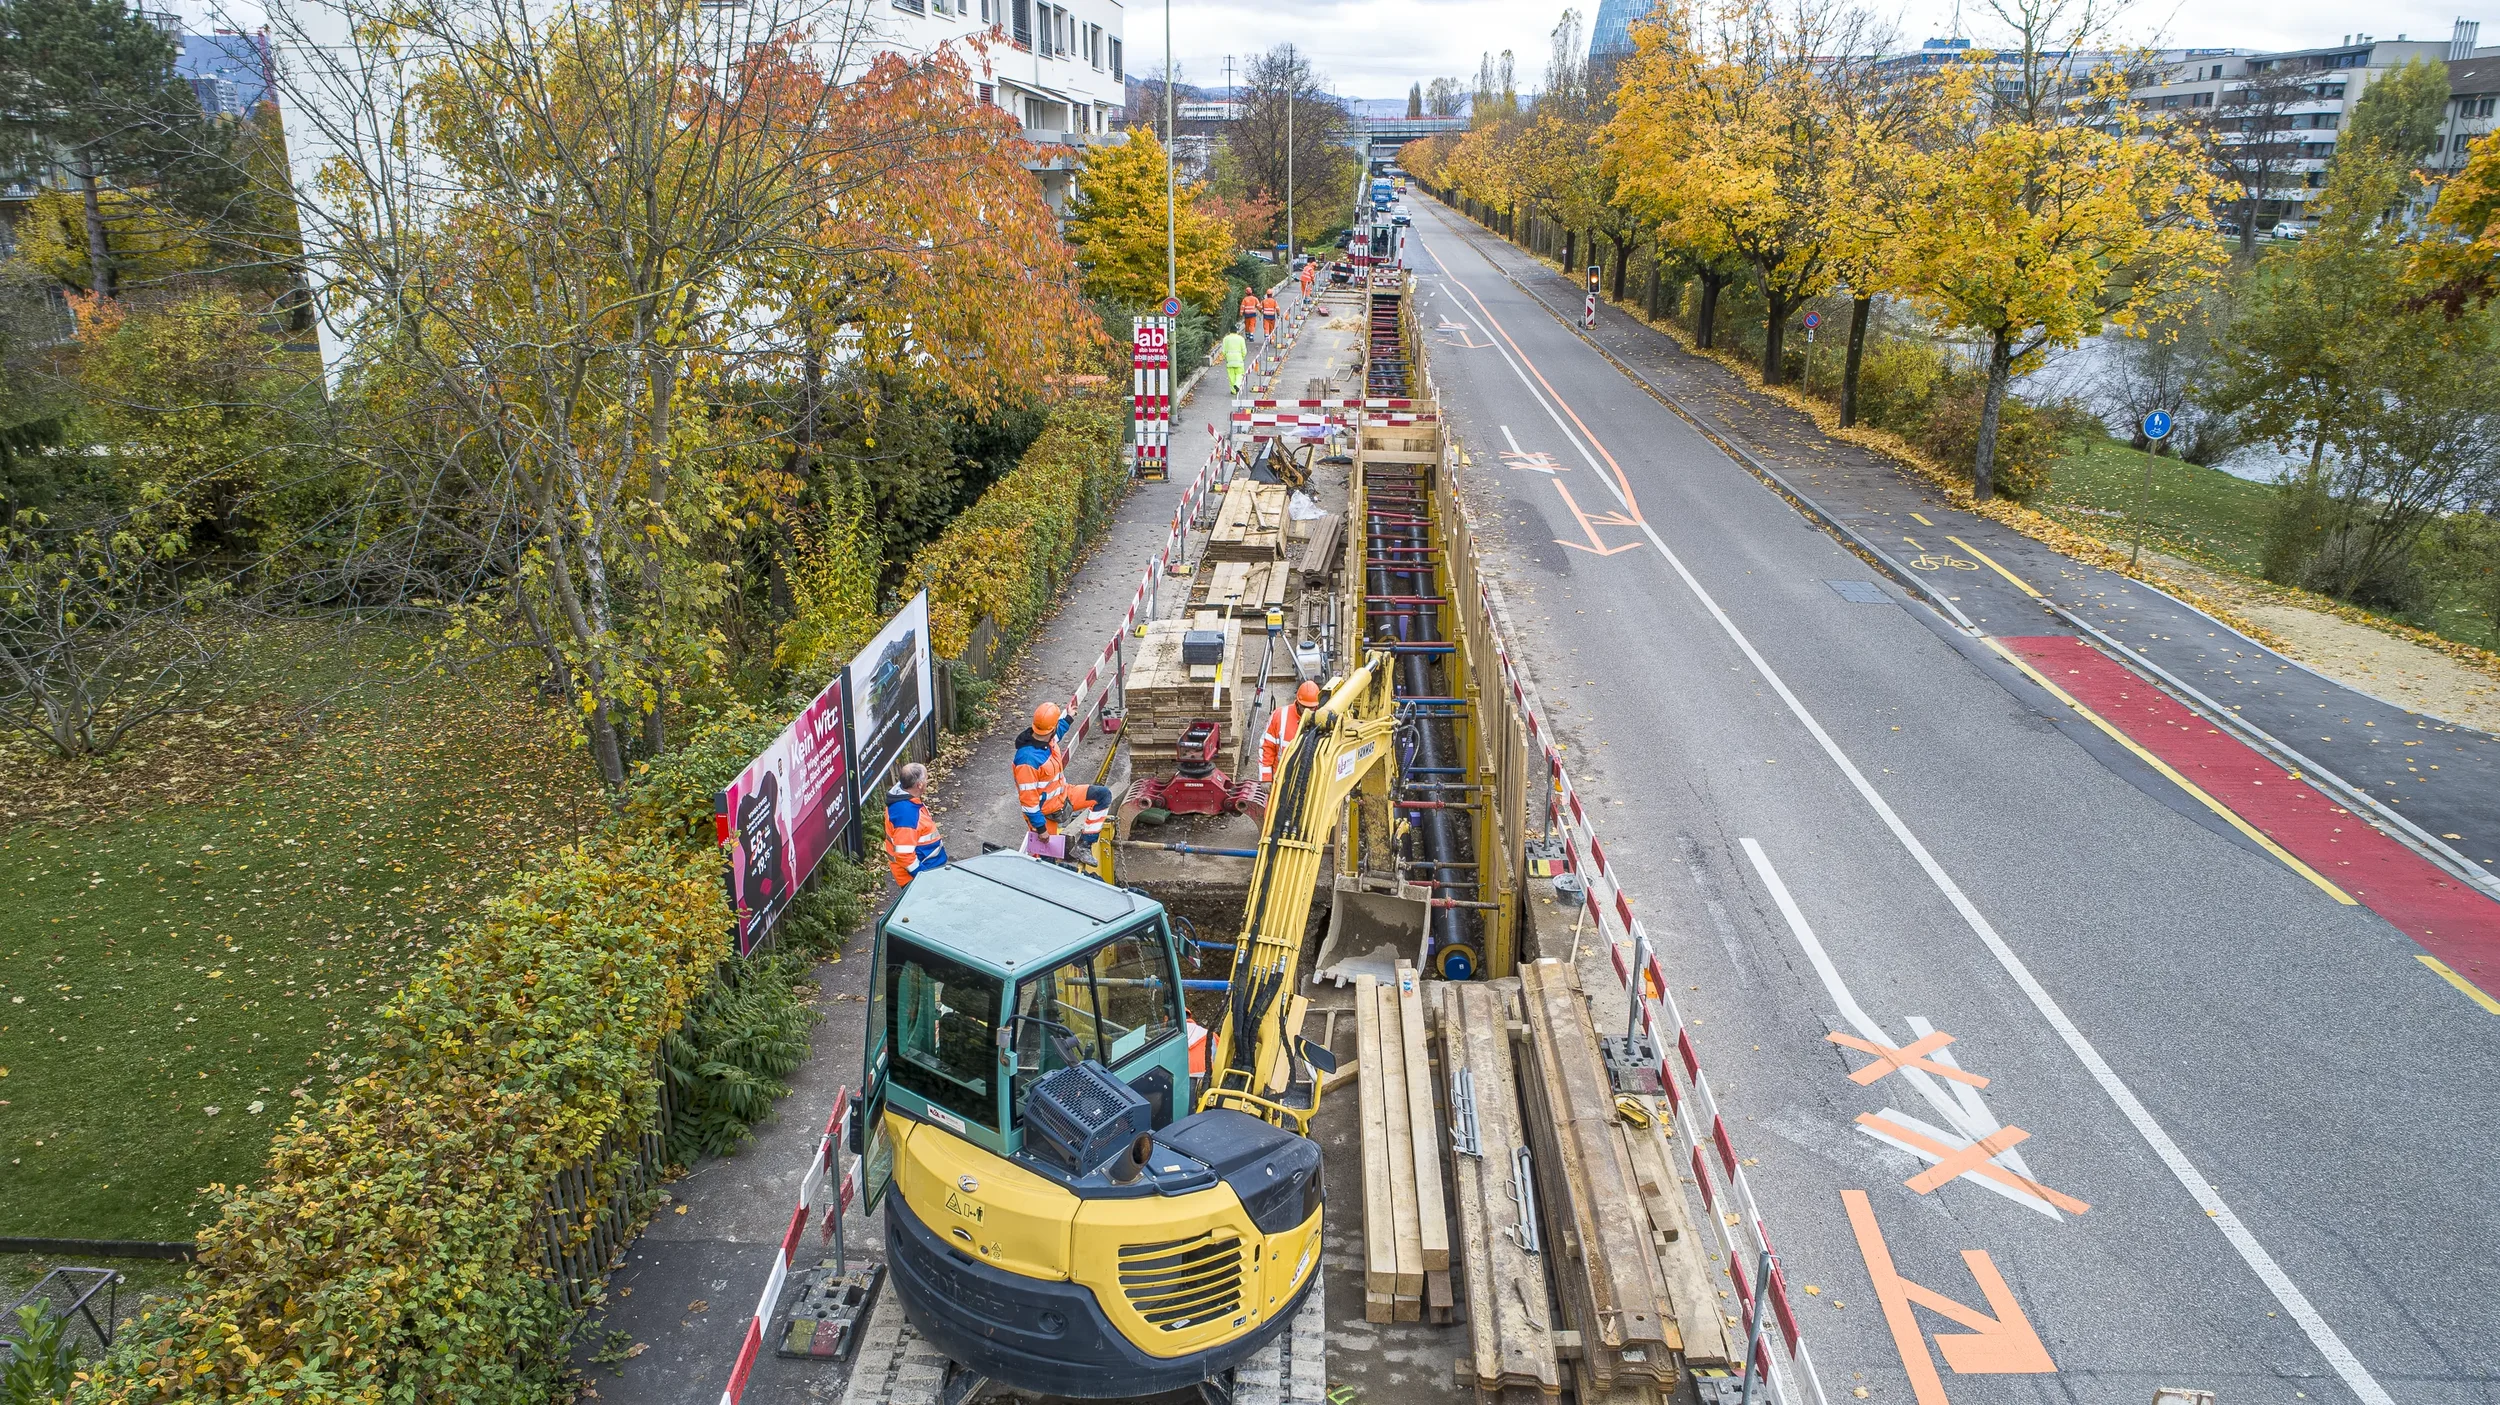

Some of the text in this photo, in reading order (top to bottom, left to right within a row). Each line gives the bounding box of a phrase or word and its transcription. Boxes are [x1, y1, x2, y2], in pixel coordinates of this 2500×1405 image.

[1139, 329, 1164, 347] ab
[791, 731, 814, 770] Kein
[819, 737, 835, 758] machen
[810, 766, 821, 784] Black
[820, 755, 833, 776] Friday
[832, 744, 841, 759] zum
[804, 786, 815, 806] Black
[826, 793, 843, 819] wingo
